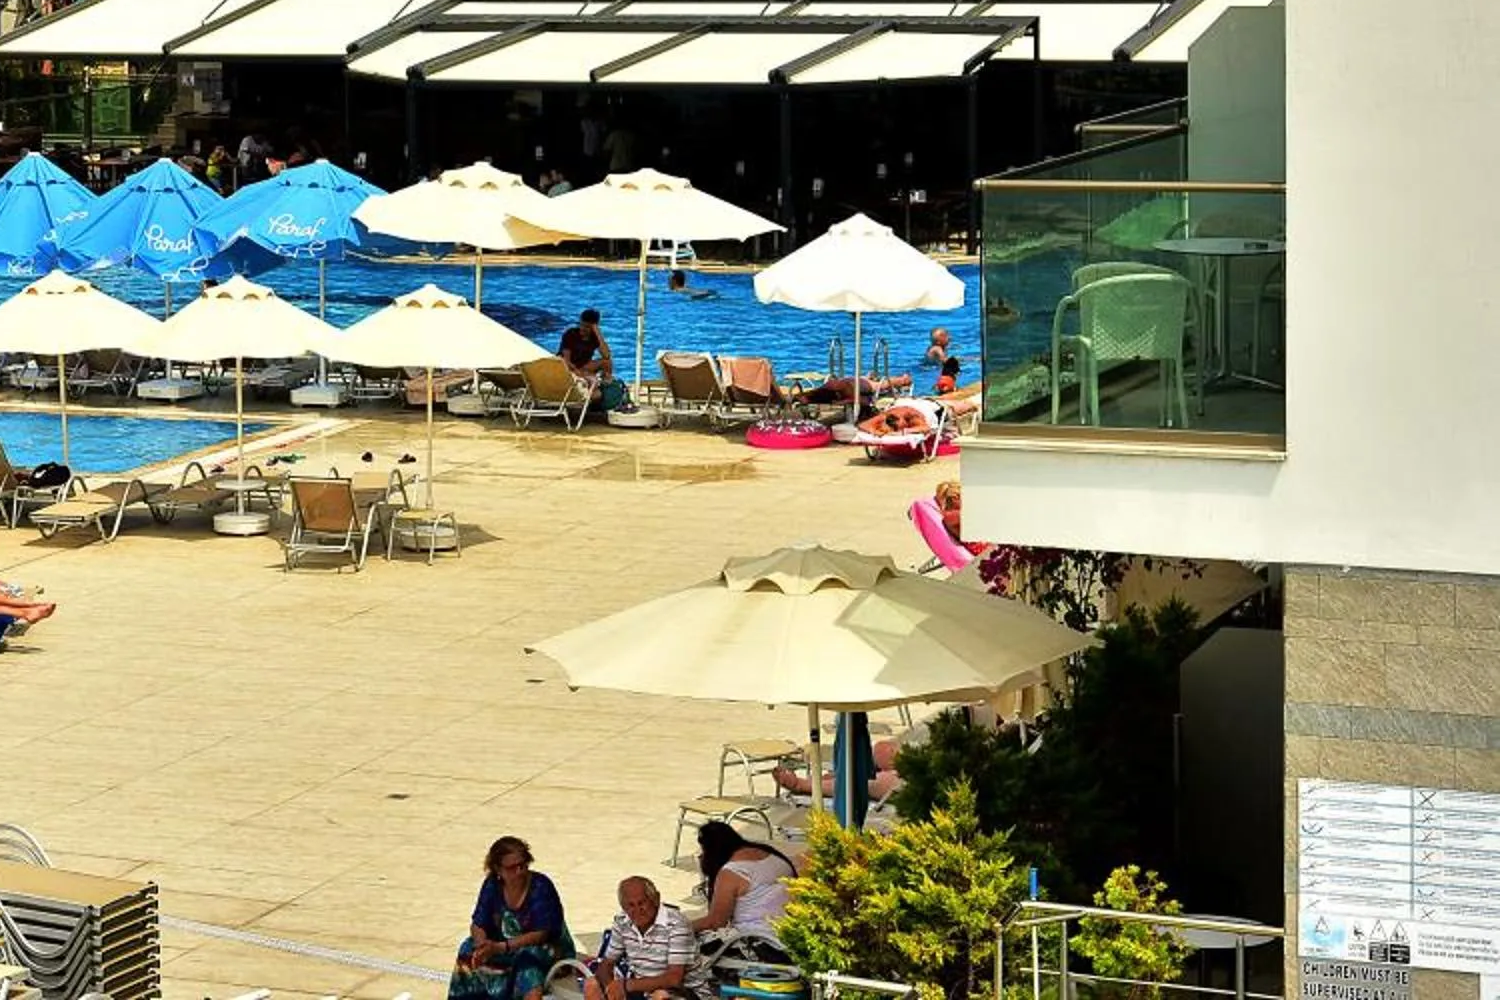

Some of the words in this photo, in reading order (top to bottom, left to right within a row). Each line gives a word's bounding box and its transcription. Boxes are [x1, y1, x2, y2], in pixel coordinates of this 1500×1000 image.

[1303, 961, 1357, 979] CHILDREN
[1361, 967, 1391, 982] MUST
[1395, 971, 1409, 985] BE
